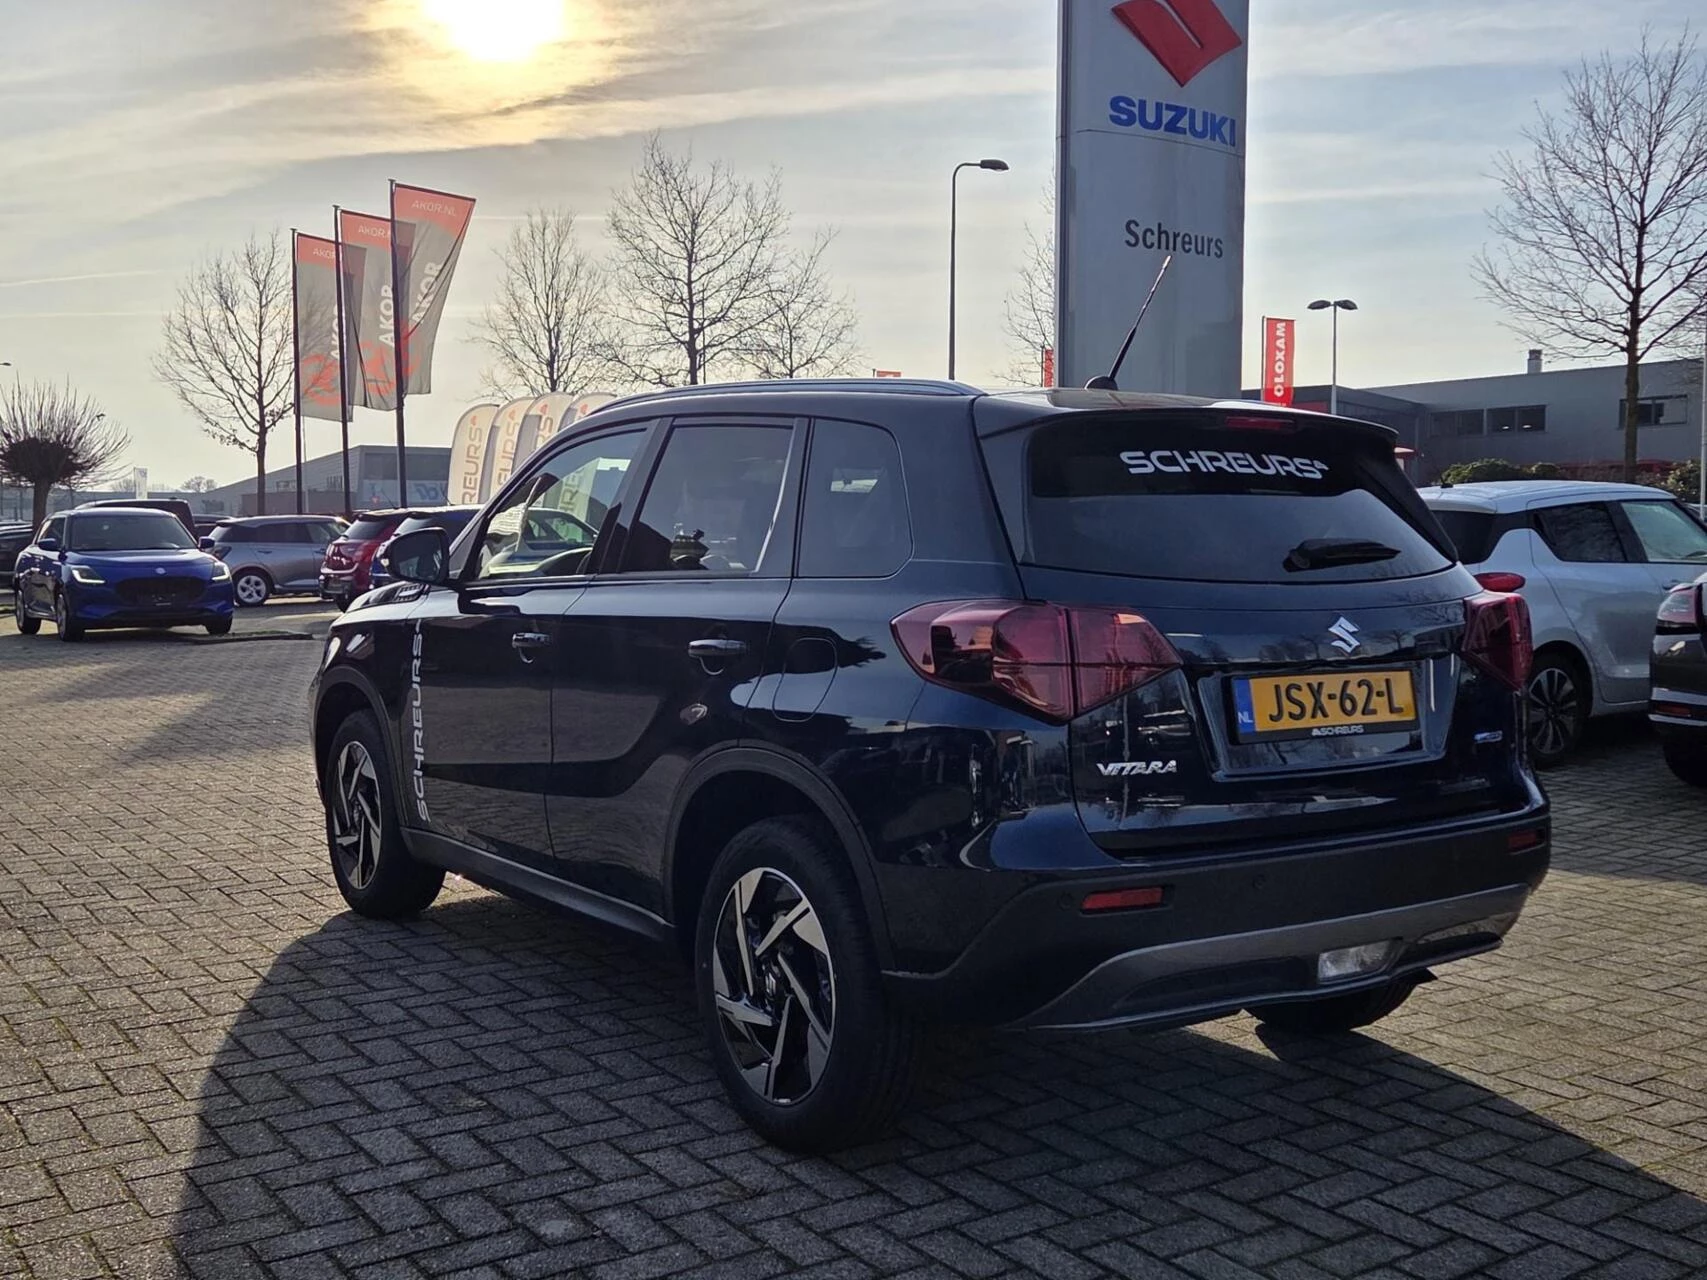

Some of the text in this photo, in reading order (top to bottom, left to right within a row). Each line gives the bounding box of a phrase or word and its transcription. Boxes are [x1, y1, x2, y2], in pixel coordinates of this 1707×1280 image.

[1109, 95, 1236, 147] SUZUKI
[411, 199, 456, 217] AKOR.NL
[1124, 219, 1223, 259] Schreurs
[411, 262, 442, 324] AKOR
[1119, 450, 1323, 480] SCHREURS
[1238, 711, 1253, 724] NL
[1269, 678, 1404, 722] JSX-62-L
[412, 633, 431, 823] SCHREURS
[1096, 760, 1177, 776] VITARA
